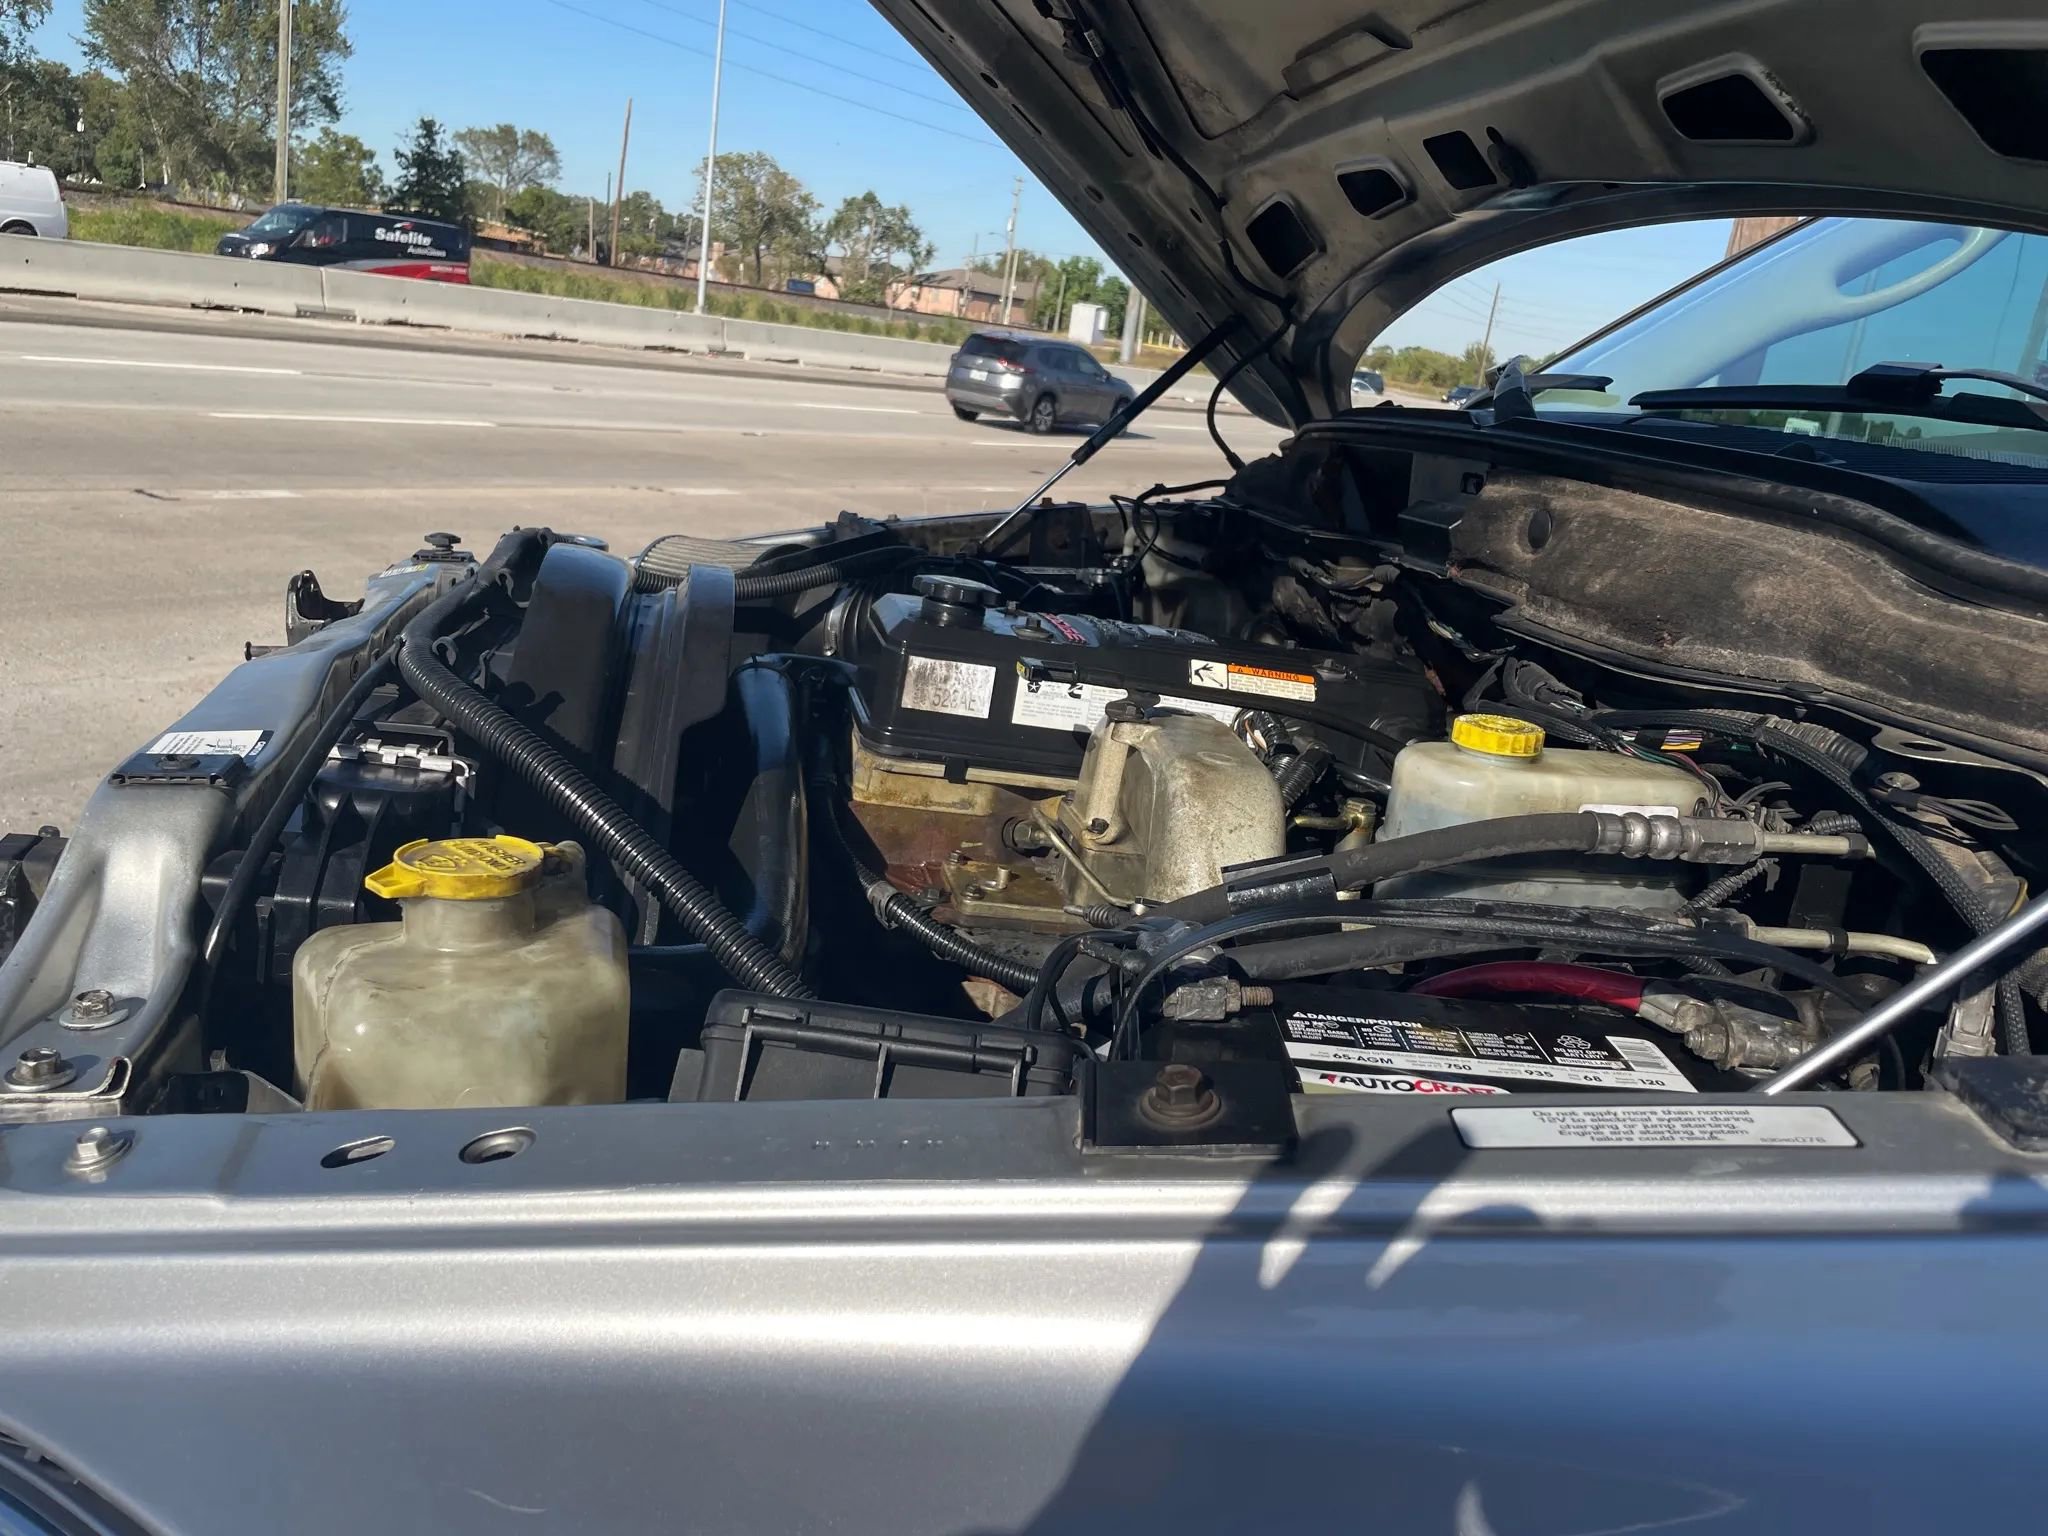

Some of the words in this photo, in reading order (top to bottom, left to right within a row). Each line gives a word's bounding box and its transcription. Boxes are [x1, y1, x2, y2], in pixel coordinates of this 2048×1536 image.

[374, 227, 432, 246] Safelite
[1251, 668, 1300, 681] WARNING
[1306, 1012, 1422, 1028] DANGER/POISON
[1333, 1052, 1394, 1065] 65-AGM
[1446, 1062, 1472, 1071] 750
[1525, 1069, 1554, 1078] 935
[1583, 1075, 1603, 1083] 68
[1639, 1078, 1666, 1087] 120
[1583, 1109, 1617, 1117] apply
[1710, 1115, 1755, 1123] during
[1698, 1129, 1749, 1137] system
